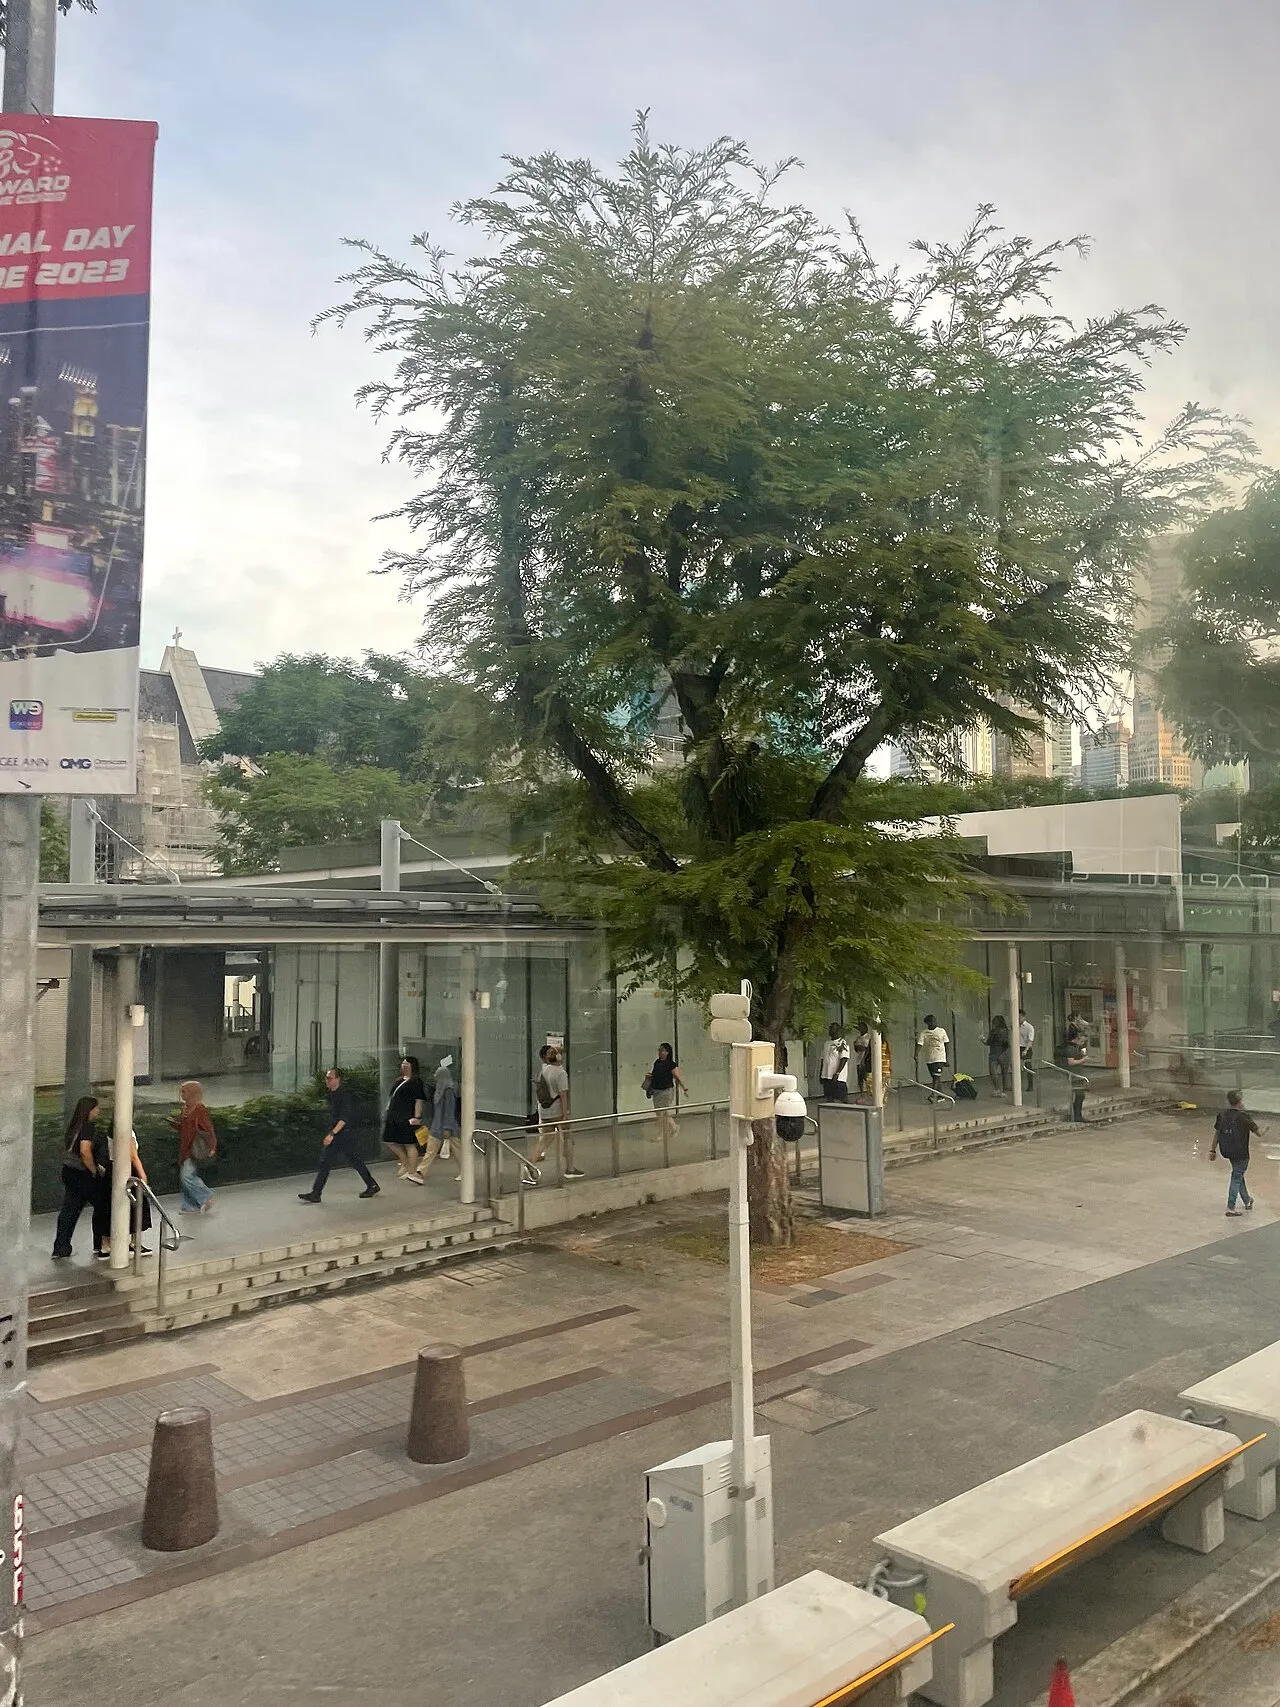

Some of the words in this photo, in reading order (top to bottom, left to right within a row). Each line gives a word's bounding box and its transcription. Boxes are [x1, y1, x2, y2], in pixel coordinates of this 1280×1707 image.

[62, 224, 136, 252] DAY
[34, 258, 130, 286] 2023
[60, 758, 92, 769] OMG
